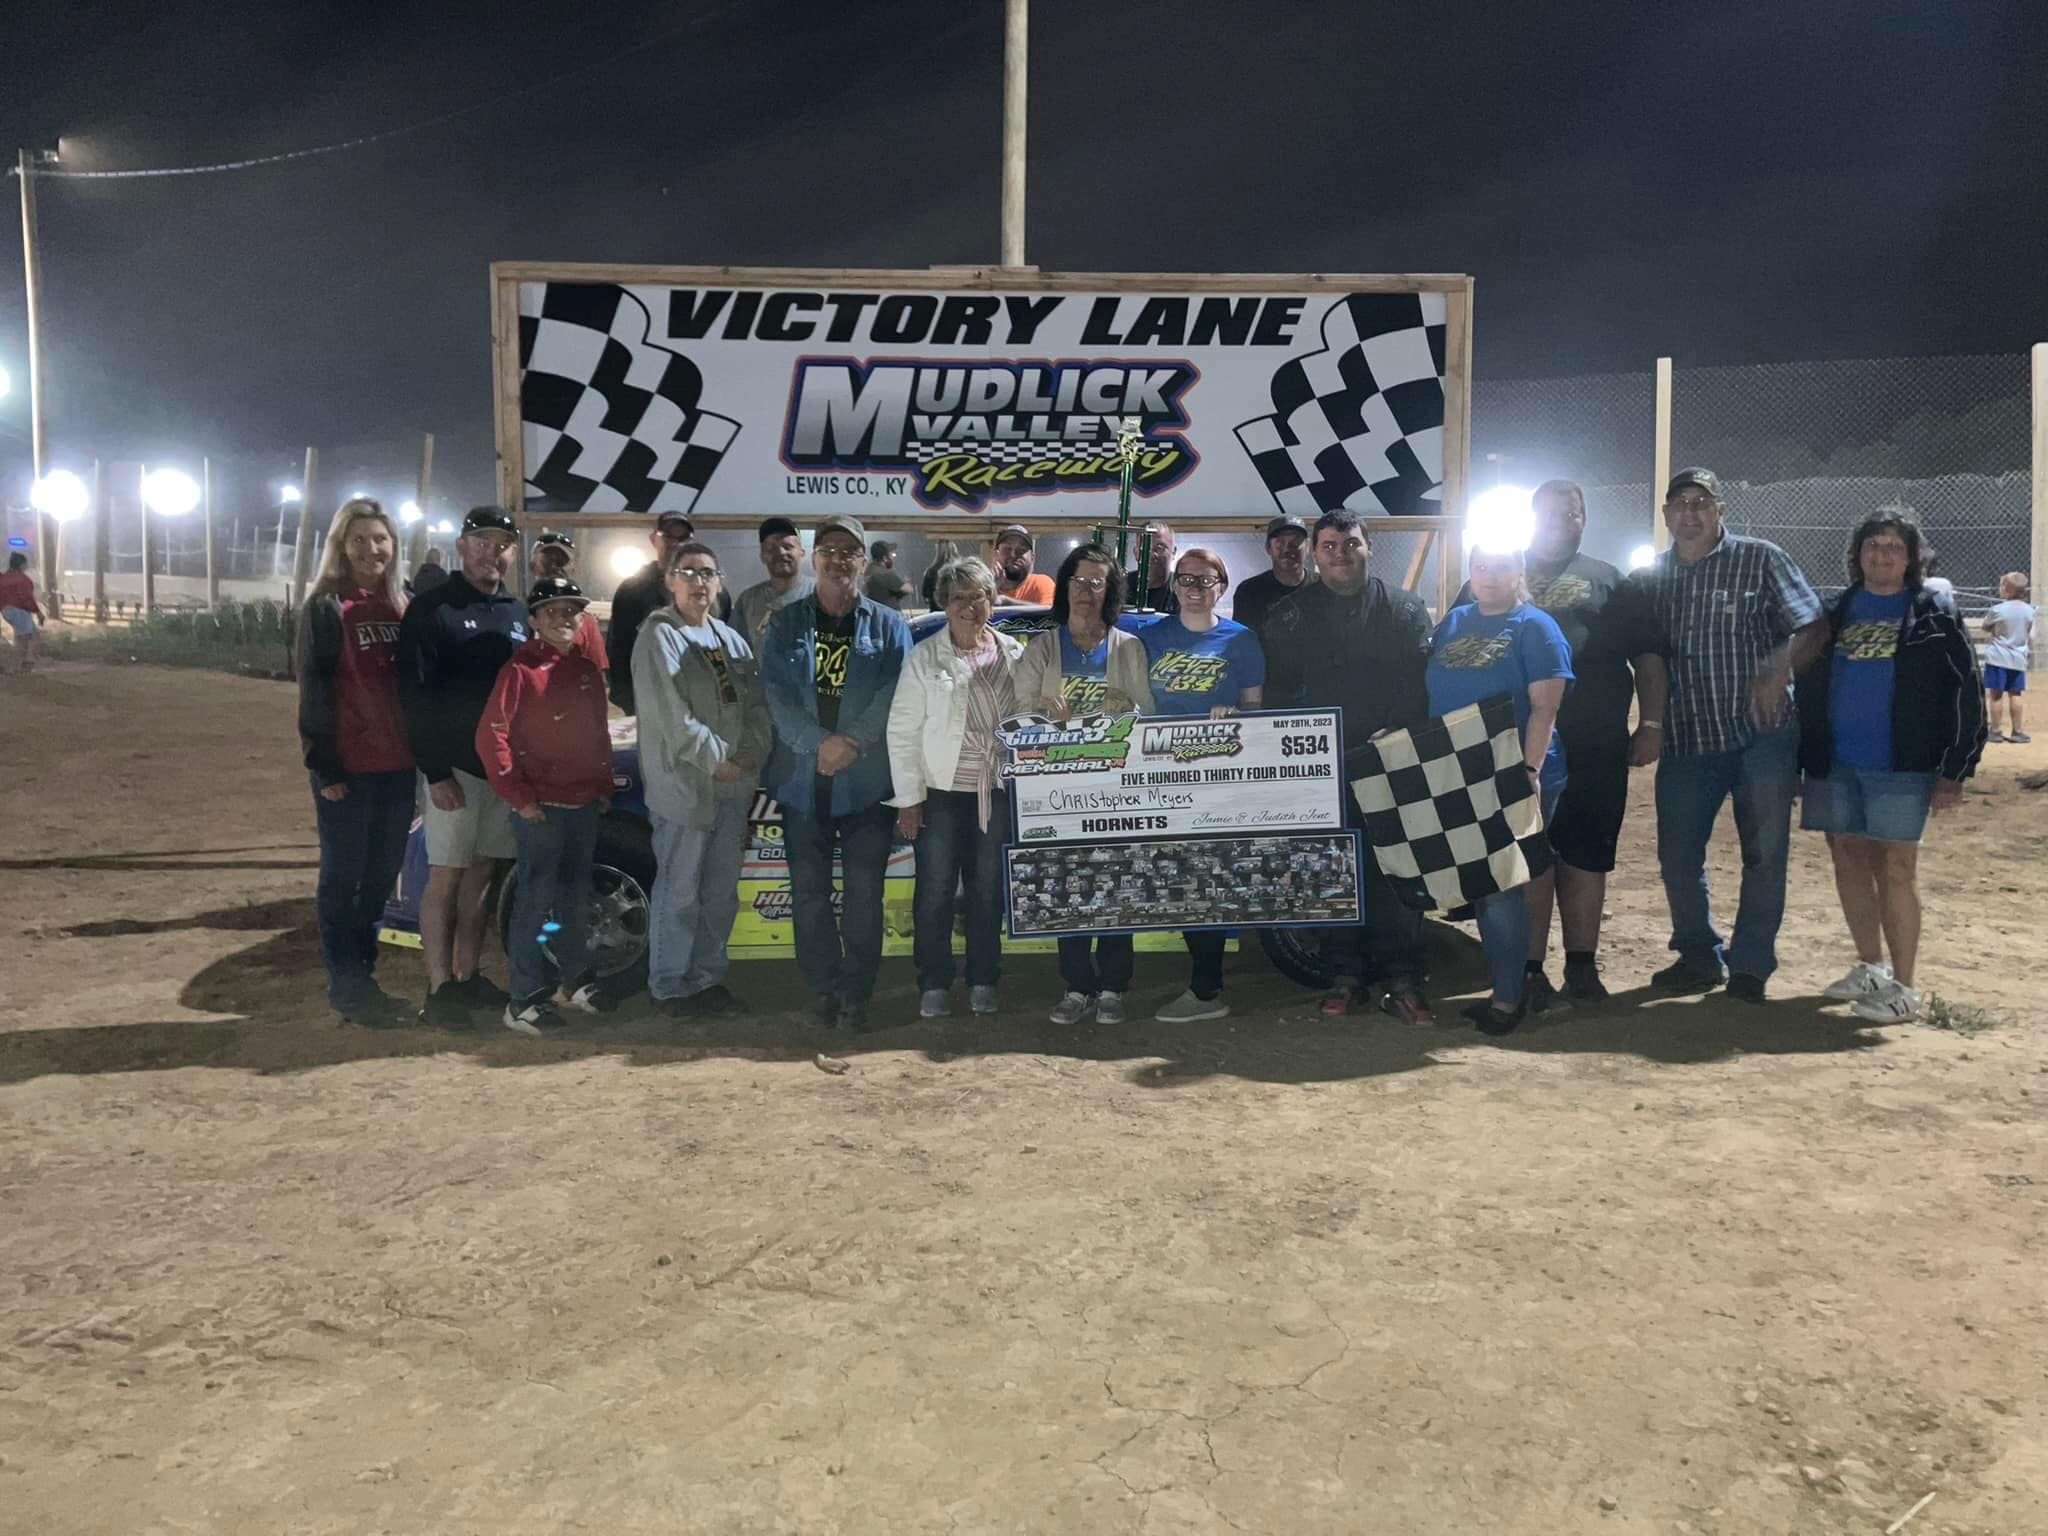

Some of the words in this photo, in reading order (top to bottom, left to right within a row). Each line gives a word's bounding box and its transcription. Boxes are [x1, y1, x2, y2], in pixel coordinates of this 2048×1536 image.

[668, 289, 1066, 345] VICTORY
[1079, 297, 1307, 346] LANE
[791, 366, 1178, 456] MUDLICK
[786, 476, 840, 494] LEWIS
[845, 477, 880, 498] CO.,
[886, 478, 907, 495] KY
[1150, 652, 1226, 675] MEYER
[1082, 715, 1138, 742] 34
[1273, 719, 1289, 728] MAY
[1313, 718, 1332, 727] 2023
[1143, 723, 1237, 752] MUDLICK
[1172, 736, 1228, 746] VALLEY
[1281, 734, 1330, 758] $534
[1003, 761, 1108, 775] MEMORIAL
[1121, 772, 1145, 786] FIVE
[1147, 770, 1201, 785] HUNDRED
[1204, 768, 1244, 782] THIRTY
[1247, 766, 1277, 780] FOUR
[1279, 764, 1332, 779] DOLLARS
[1148, 787, 1193, 809] Meyers
[1081, 815, 1168, 833] HORNETS
